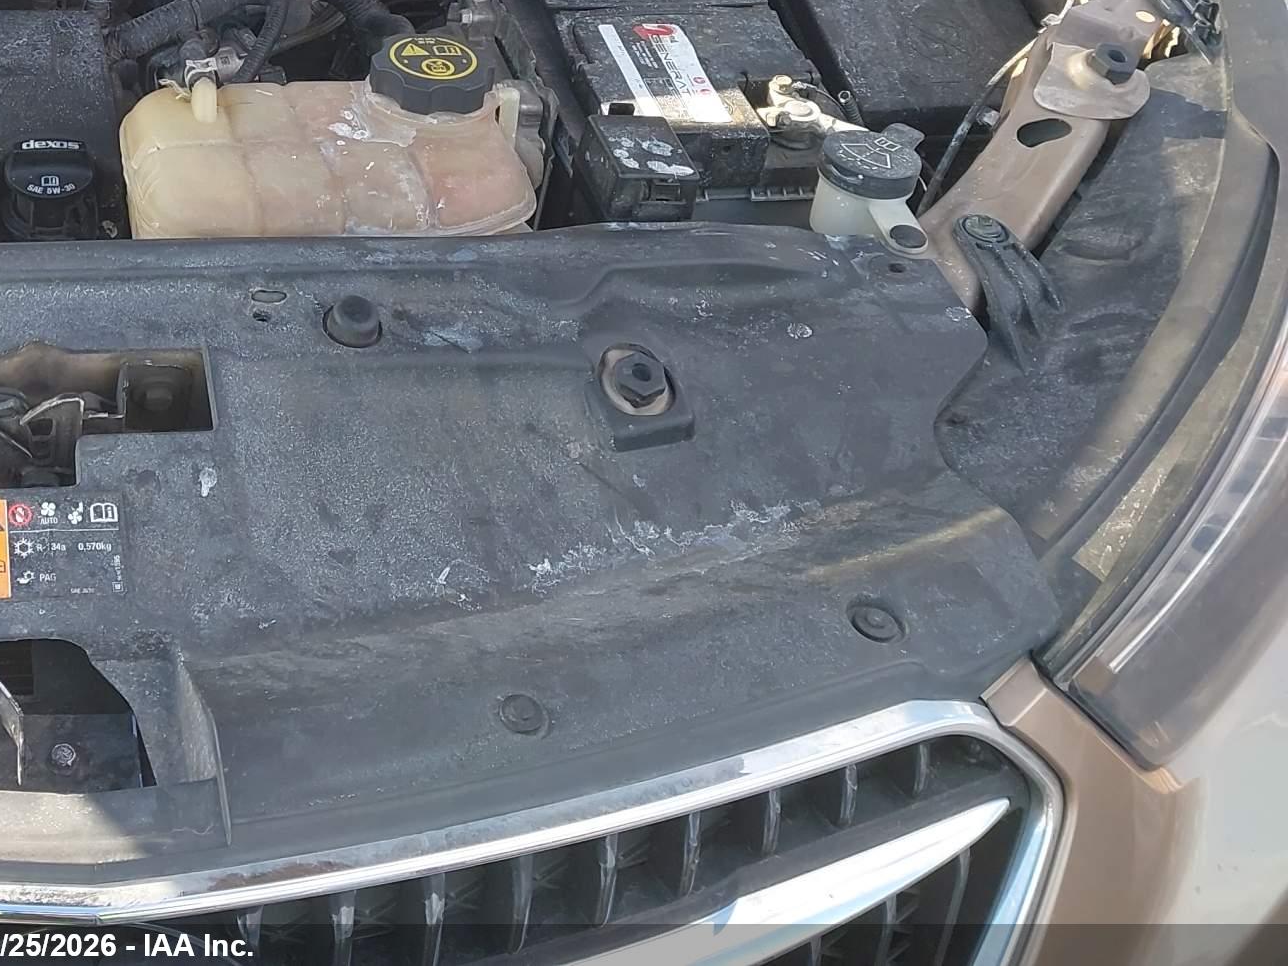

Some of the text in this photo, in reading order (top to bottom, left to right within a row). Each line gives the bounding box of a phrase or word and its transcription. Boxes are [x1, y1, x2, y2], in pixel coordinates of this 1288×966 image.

[21, 139, 81, 151] dexos
[26, 182, 77, 195] SAE 5W-30
[39, 516, 59, 525] AUTO
[39, 573, 57, 583] PAG
